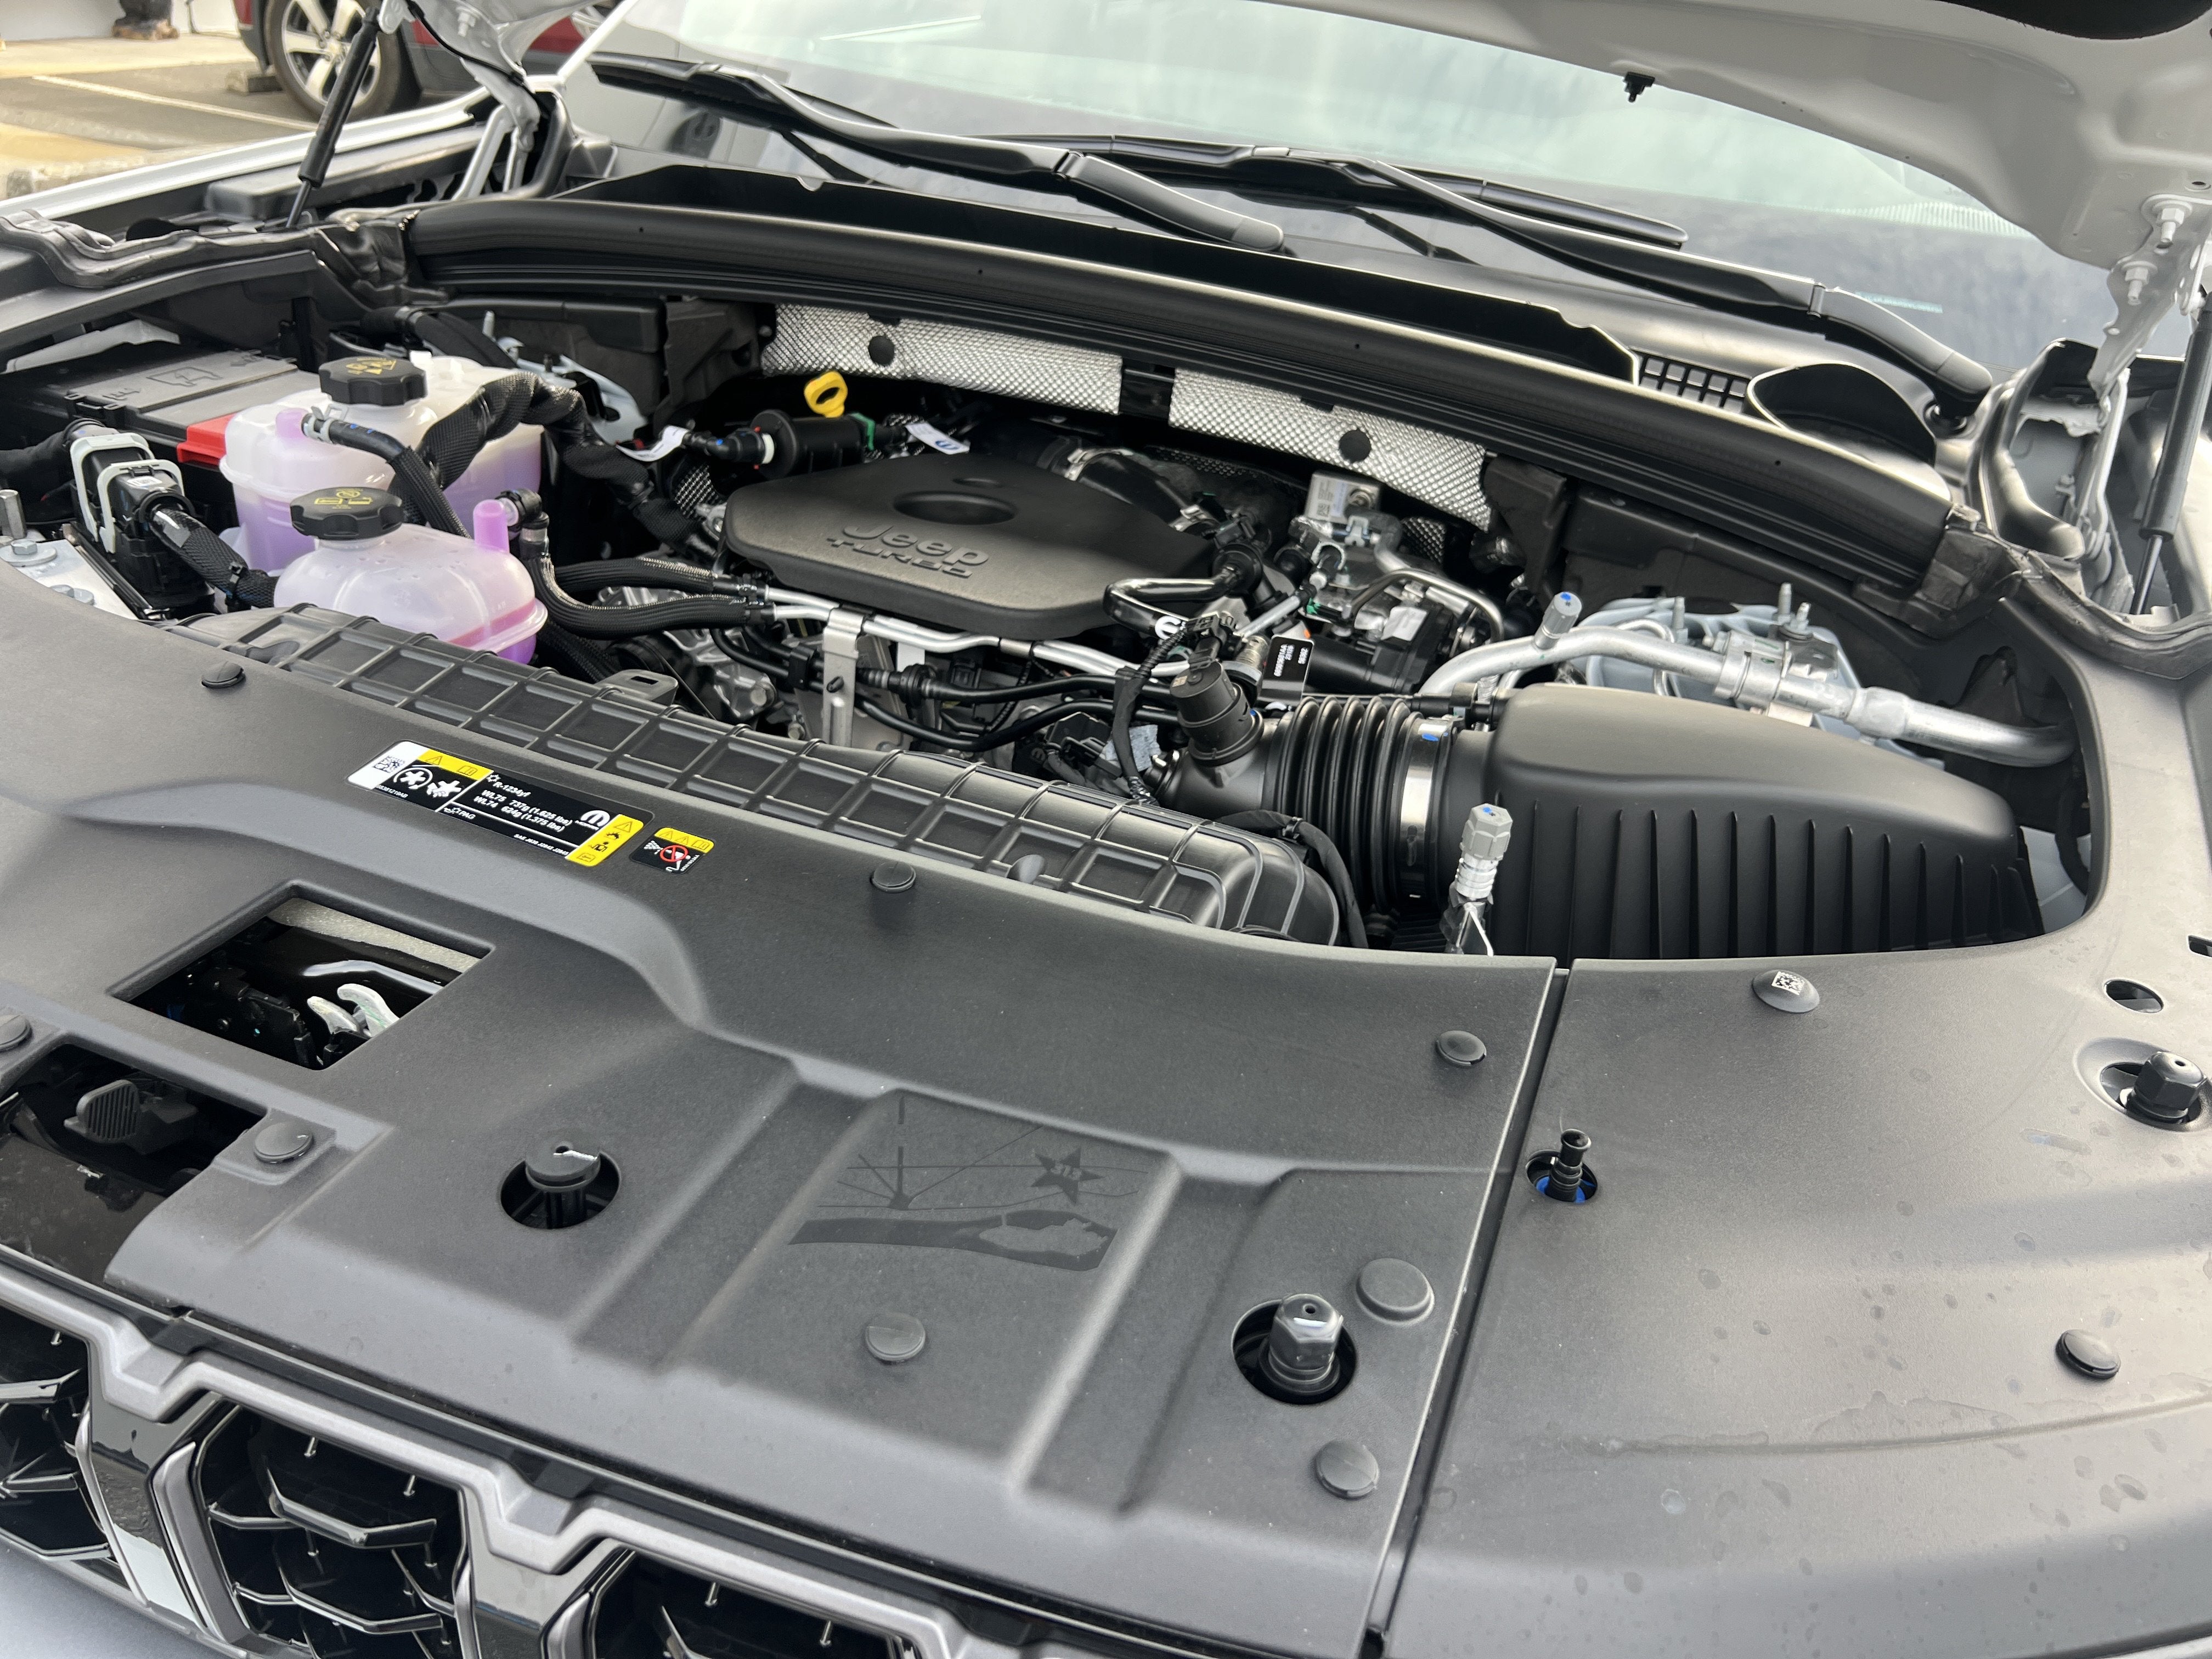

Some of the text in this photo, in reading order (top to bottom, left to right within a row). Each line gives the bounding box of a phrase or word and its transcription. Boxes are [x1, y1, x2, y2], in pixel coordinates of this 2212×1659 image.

[826, 538, 973, 579] TURBO
[842, 525, 989, 566] Jeep
[481, 789, 507, 802] WL75
[528, 807, 557, 820] (1.625
[554, 815, 573, 826] lbs)
[493, 781, 532, 798] R-1234yf
[459, 810, 476, 819] PAG
[473, 795, 499, 808] WL74
[521, 813, 549, 826] (1.375
[546, 821, 565, 832] lbs)
